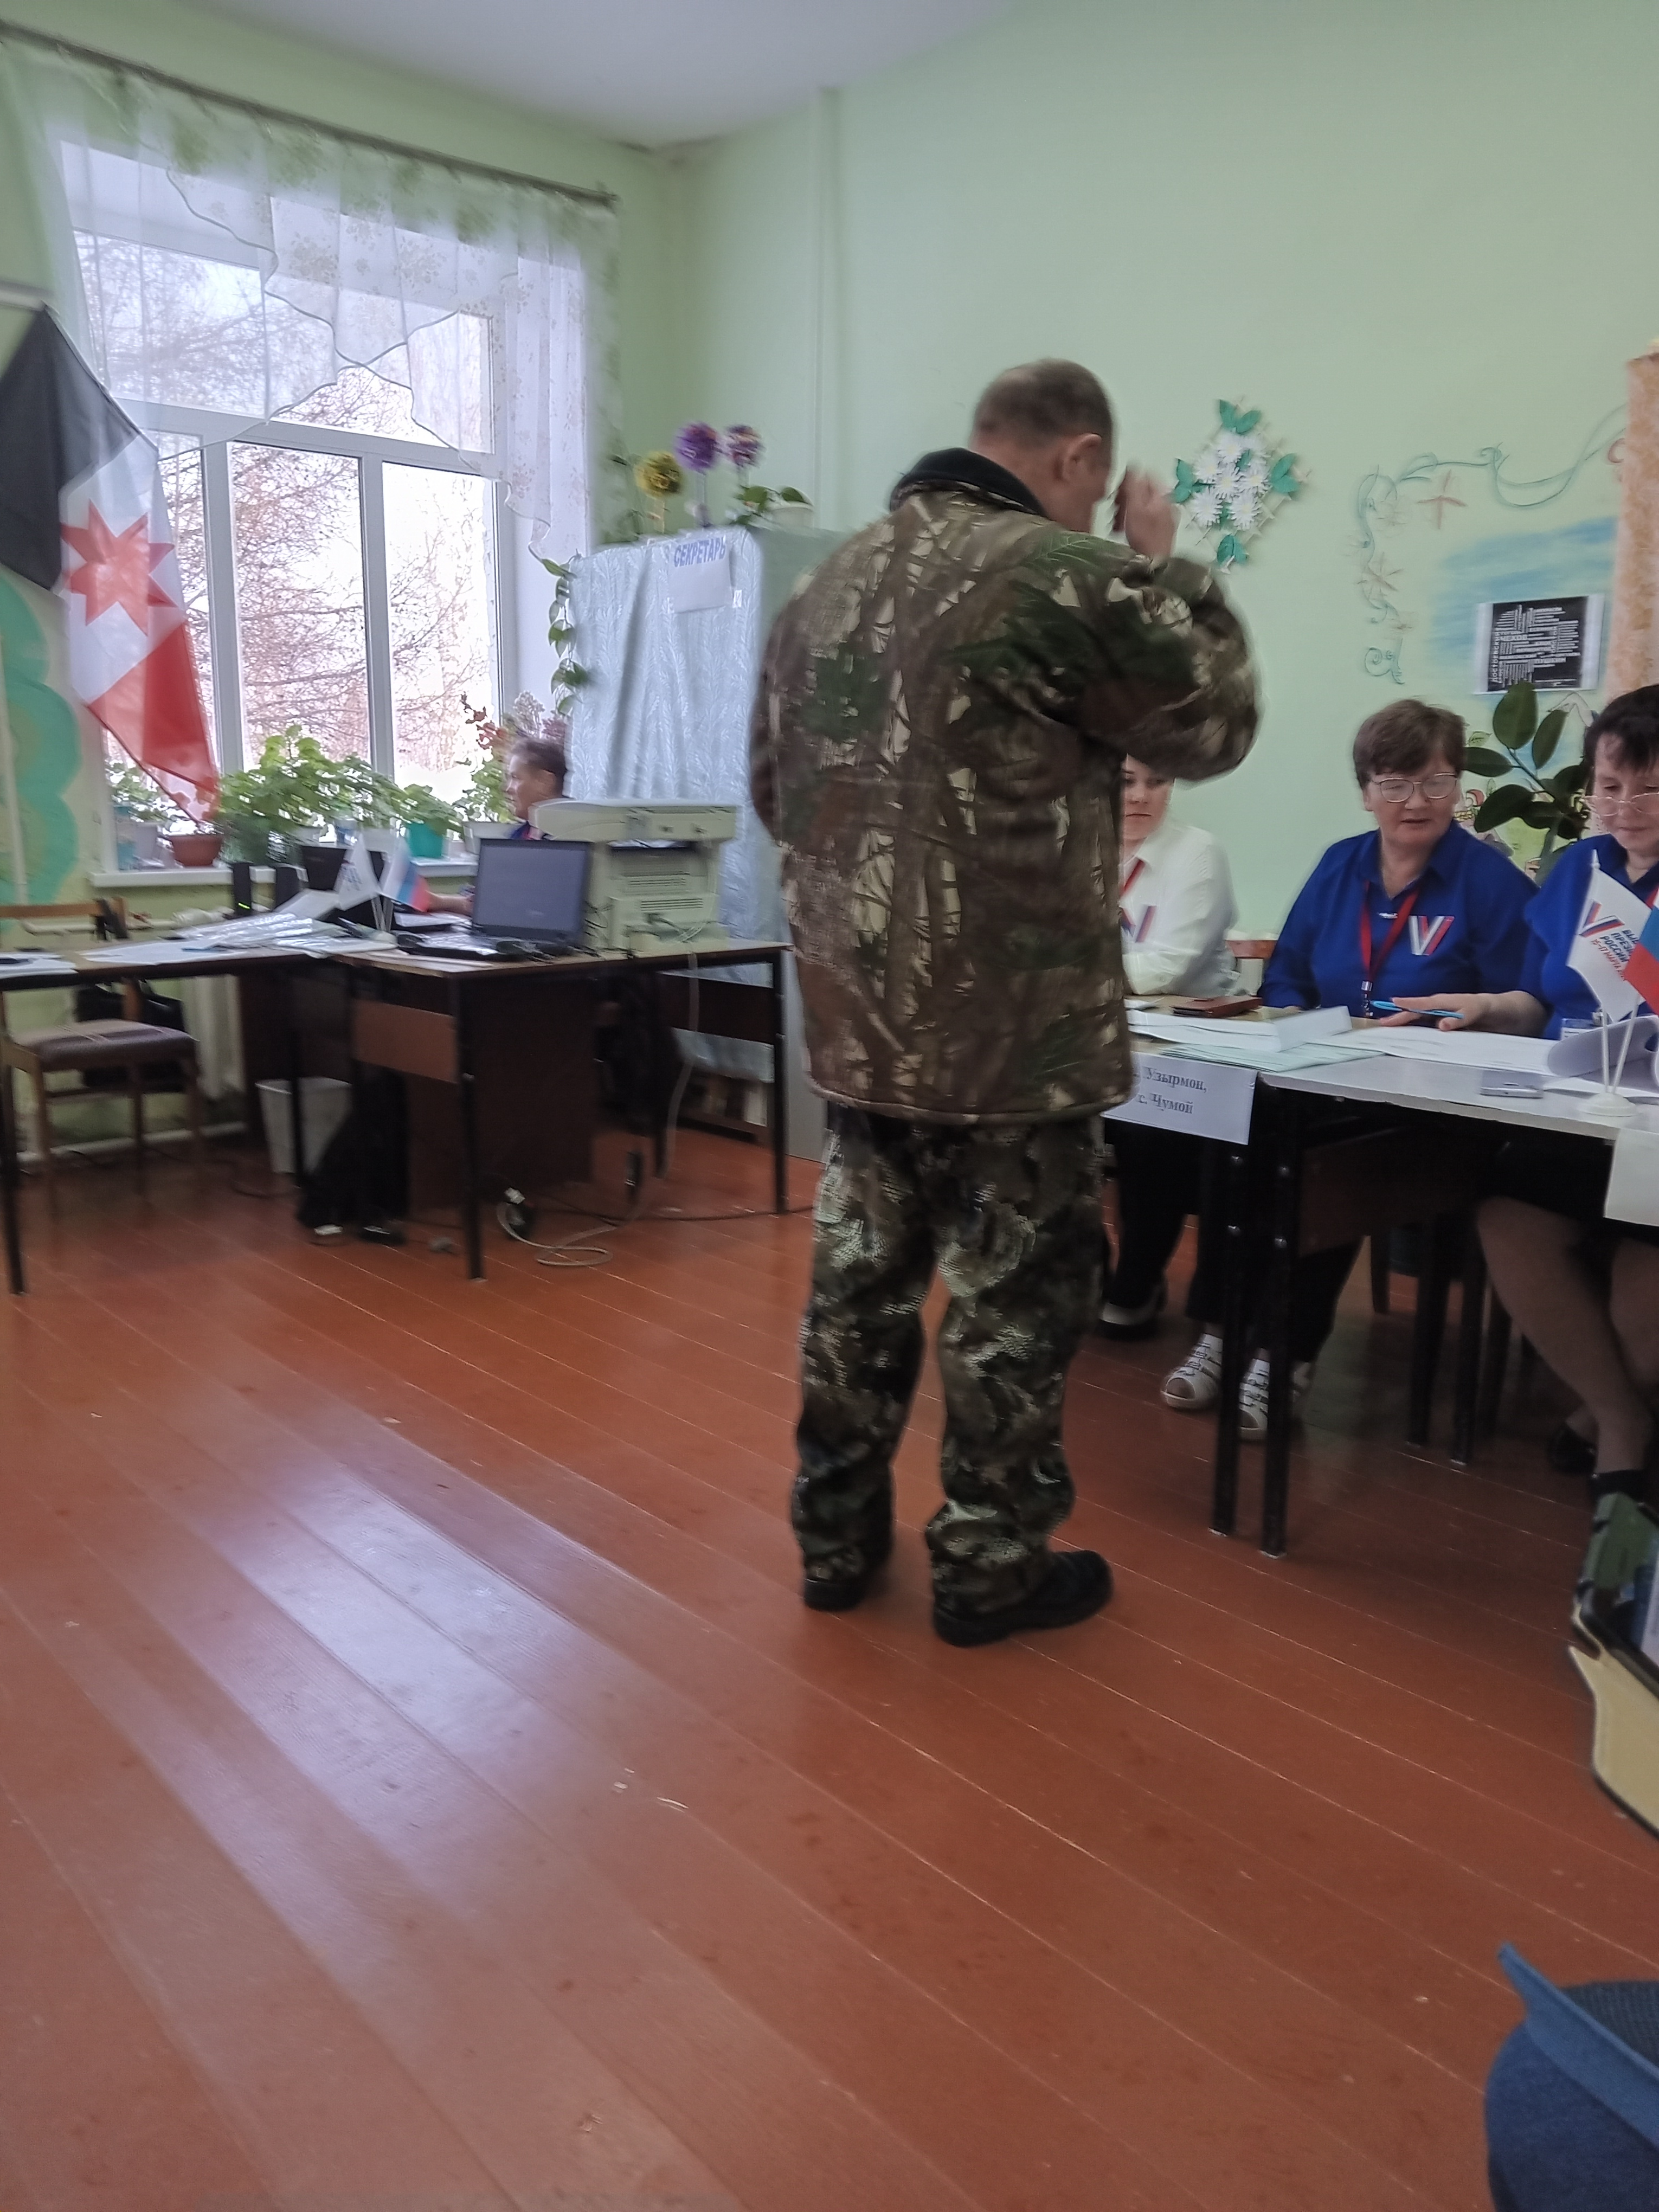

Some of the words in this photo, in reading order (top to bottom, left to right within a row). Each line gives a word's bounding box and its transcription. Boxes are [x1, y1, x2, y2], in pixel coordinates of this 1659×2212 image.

[674, 537, 725, 567] СЕКРЕТАРЬ
[1599, 936, 1629, 962] РОССИИ
[1143, 1066, 1207, 1093] Узырмон,
[1150, 1092, 1193, 1114] Чумой
